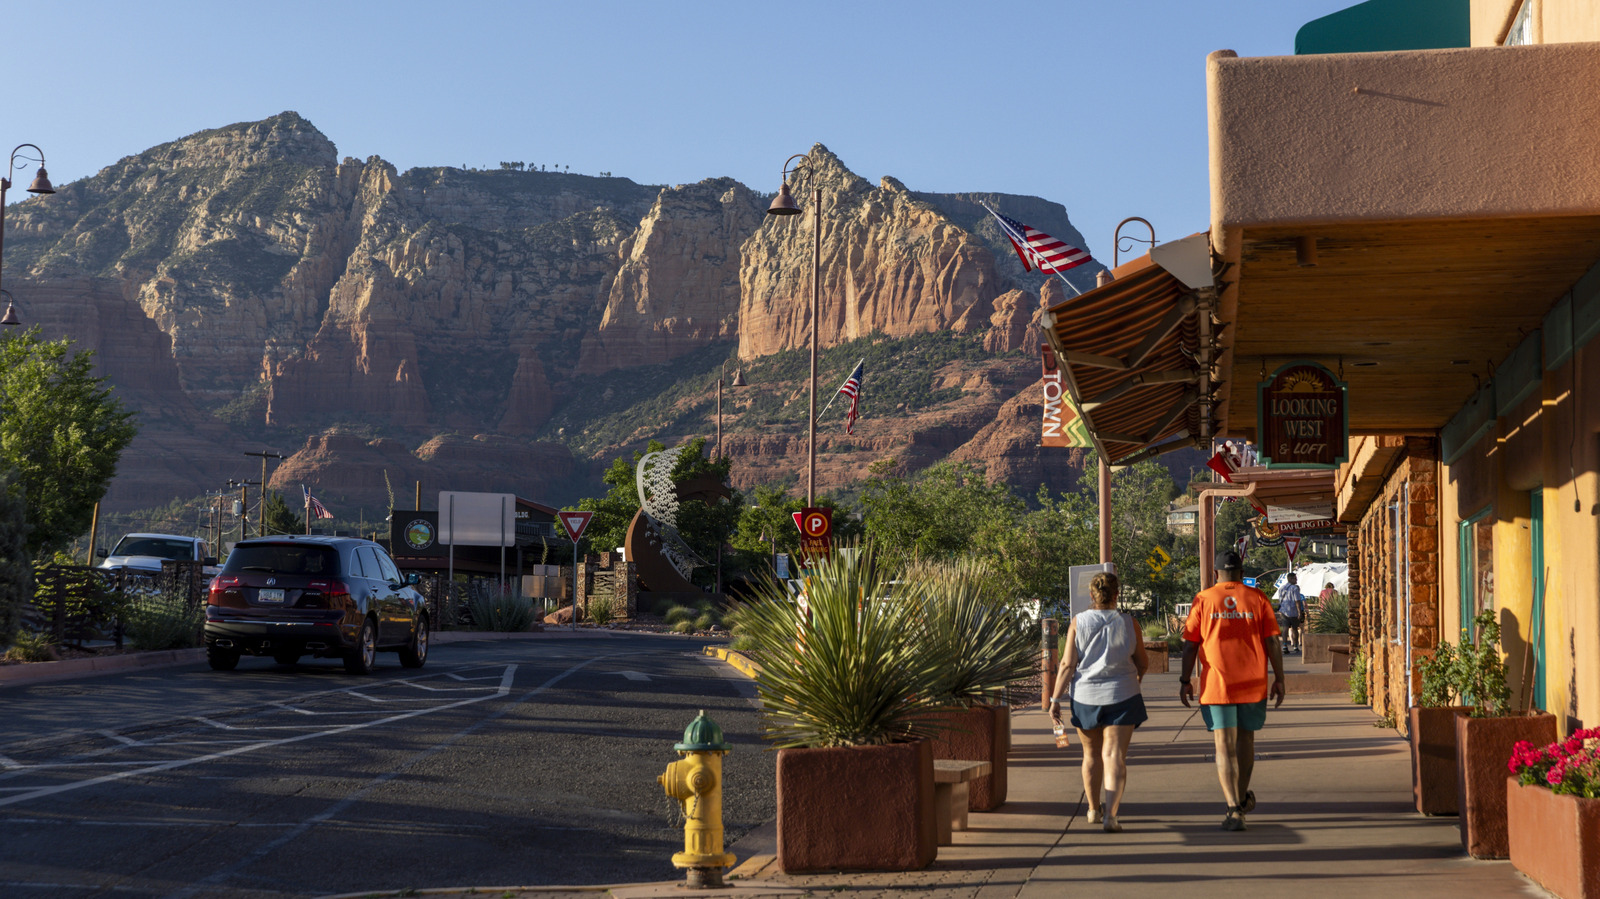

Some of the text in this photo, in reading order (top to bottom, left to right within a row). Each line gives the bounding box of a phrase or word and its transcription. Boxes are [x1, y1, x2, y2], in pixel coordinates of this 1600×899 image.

[1272, 399, 1337, 415] LOOKING
[1285, 420, 1324, 436] WEST
[1279, 443, 1327, 455] & LOFT
[811, 518, 822, 531] P
[1280, 521, 1315, 531] DAHLING
[1209, 610, 1254, 620] vodafone
